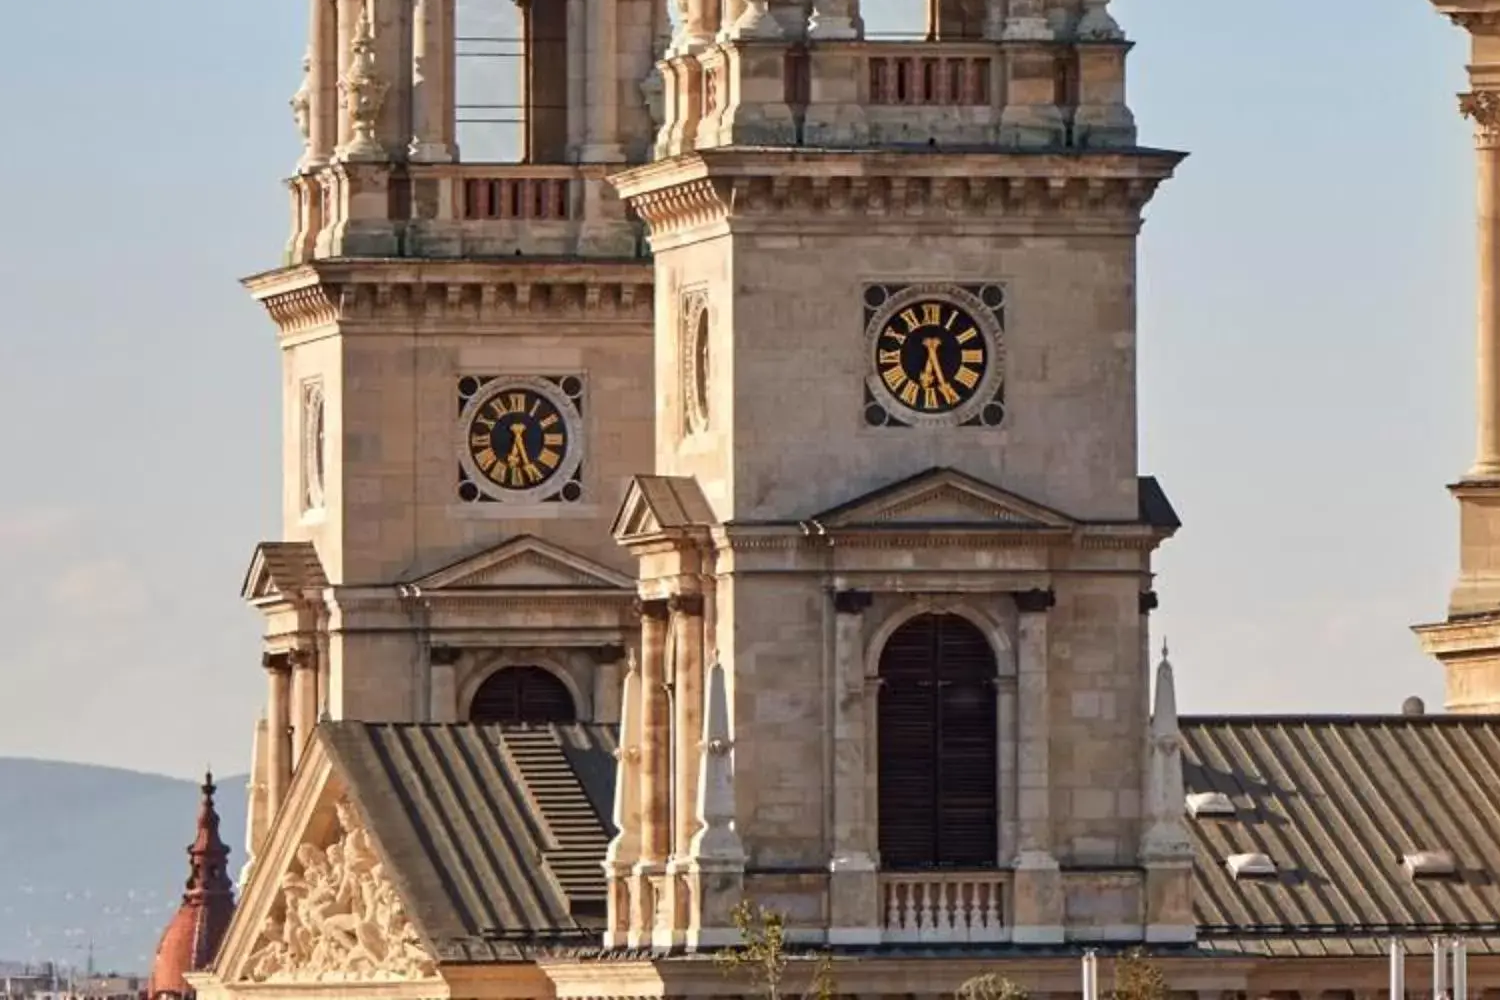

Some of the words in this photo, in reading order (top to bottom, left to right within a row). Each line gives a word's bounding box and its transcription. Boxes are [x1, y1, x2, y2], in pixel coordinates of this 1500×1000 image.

[900, 308, 921, 332] XI
[921, 303, 941, 325] XII
[945, 310, 959, 330] I
[884, 326, 907, 345] X
[955, 327, 977, 345] II
[879, 349, 901, 363] IX
[961, 349, 983, 363] III
[882, 365, 908, 390] VIII
[508, 393, 527, 413] XII
[900, 380, 919, 406] VII
[924, 387, 939, 409] VI
[489, 397, 509, 418] XI
[529, 398, 542, 418] I
[475, 413, 497, 430] X
[540, 412, 559, 430] II
[471, 432, 491, 447] IX
[543, 433, 563, 446] III
[489, 460, 507, 482] VII
[511, 466, 524, 486] VI
